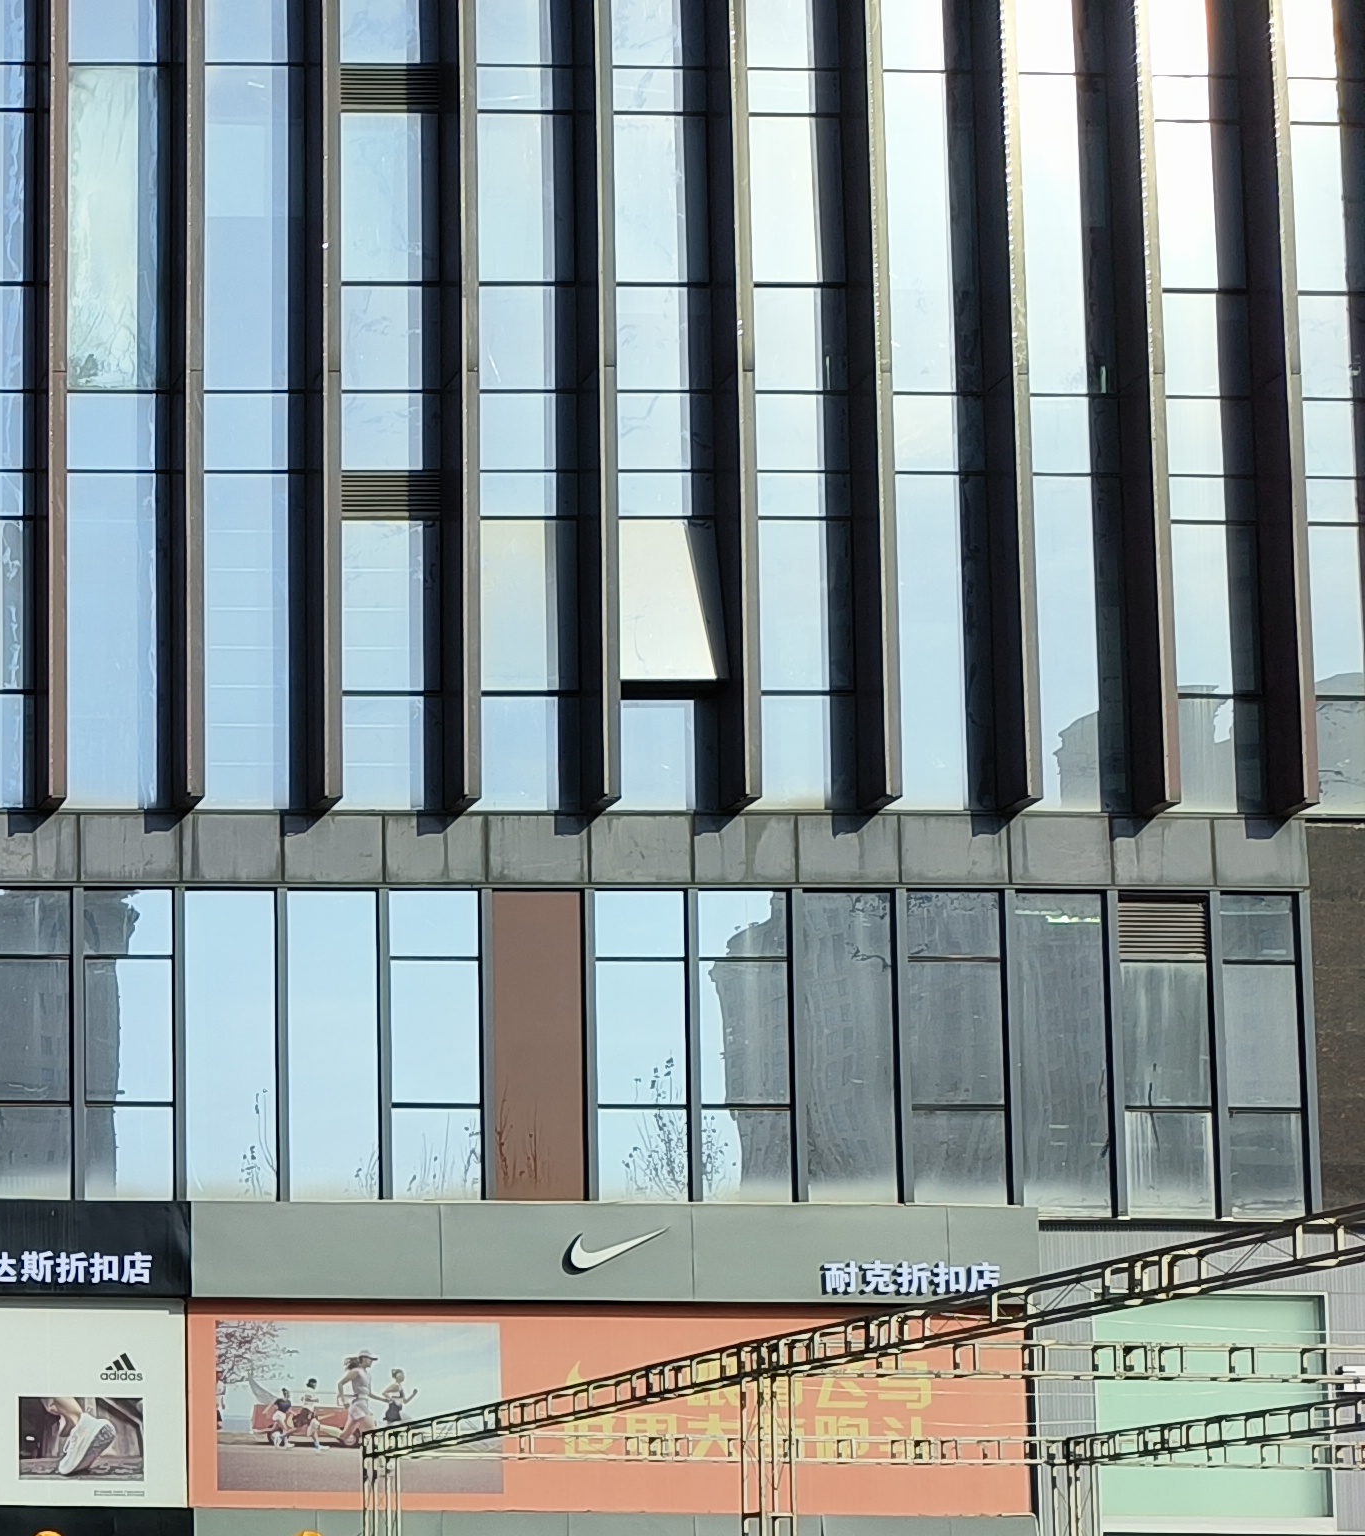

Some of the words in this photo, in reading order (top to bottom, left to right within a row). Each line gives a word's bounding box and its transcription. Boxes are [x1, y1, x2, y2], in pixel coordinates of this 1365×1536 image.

[822, 1260, 1001, 1294] 耐克折扣店
[99, 1370, 143, 1381] adidas
